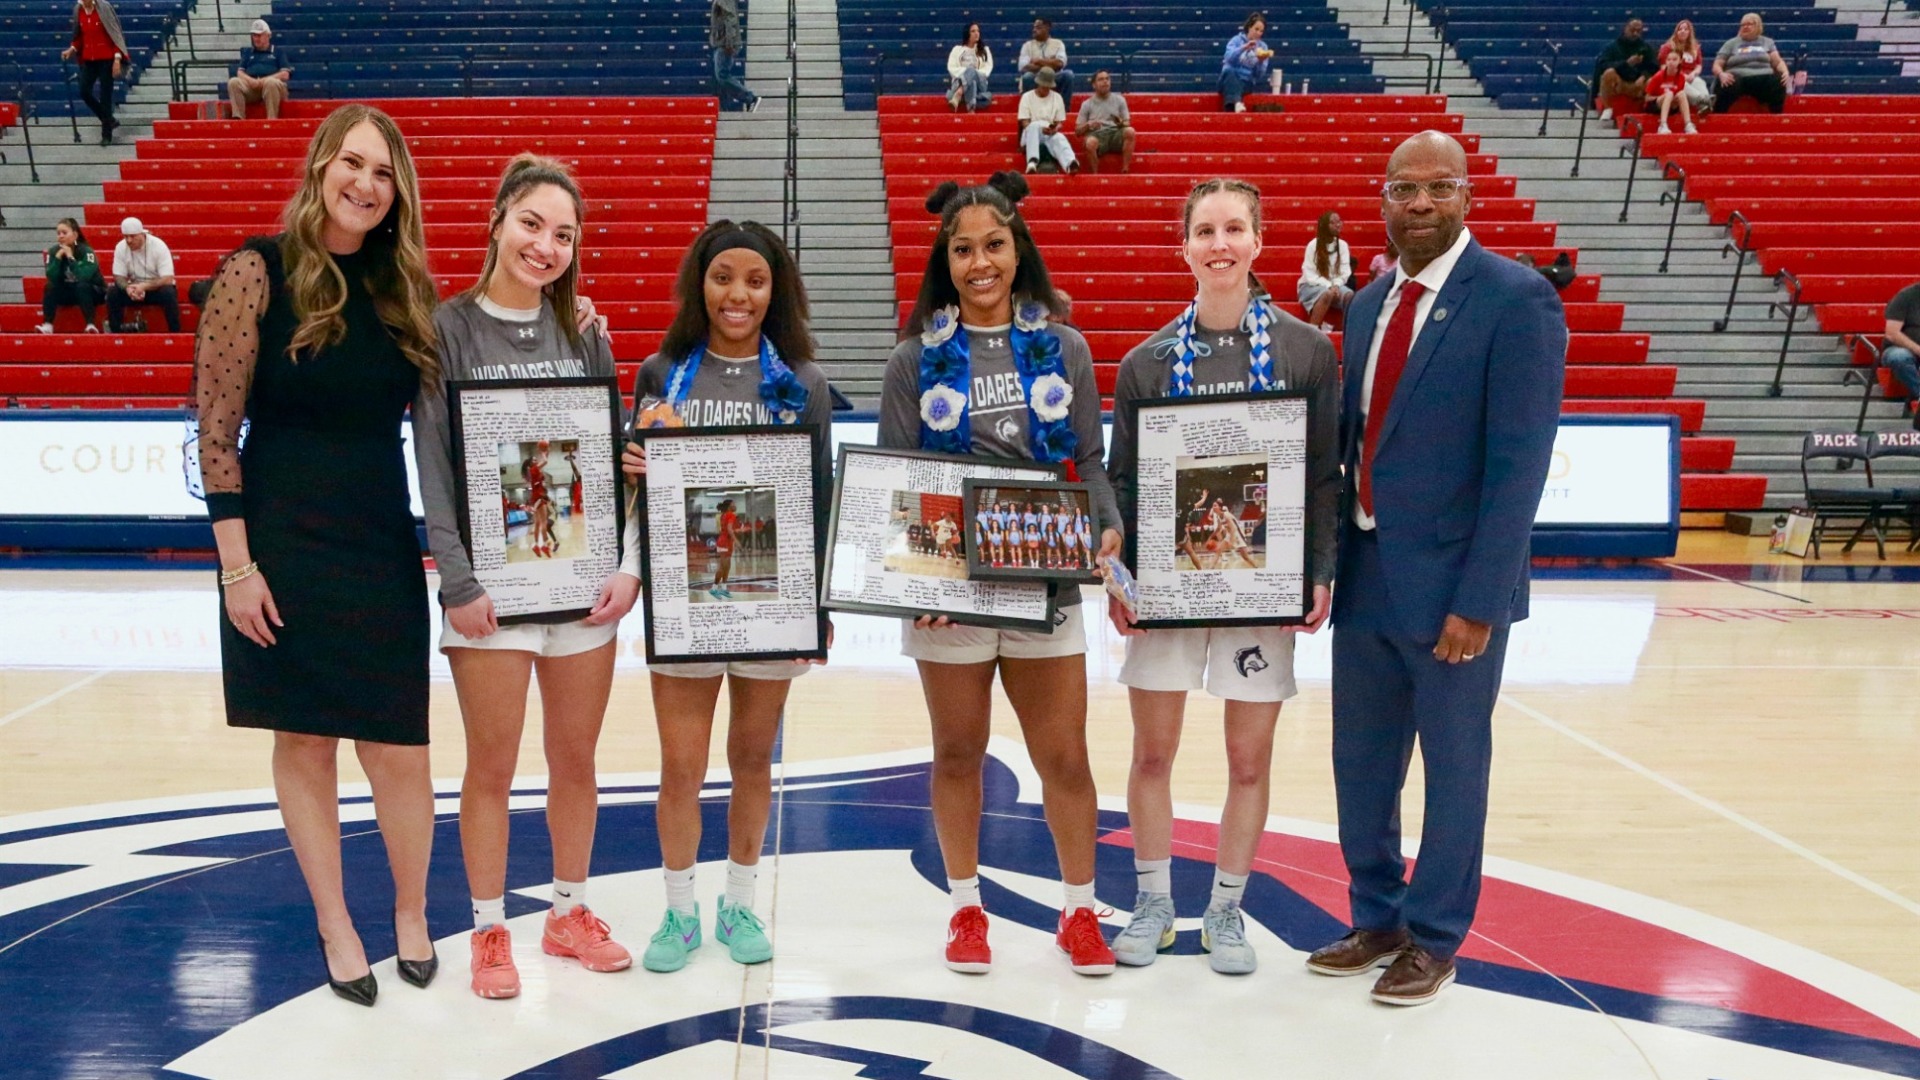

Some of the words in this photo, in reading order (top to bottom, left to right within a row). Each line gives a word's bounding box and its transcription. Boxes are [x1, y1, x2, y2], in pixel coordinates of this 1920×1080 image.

[974, 372, 1025, 407] DARES
[681, 399, 700, 427] HO
[704, 399, 752, 427] DARES
[1813, 434, 1858, 447] PACK
[1877, 433, 1920, 446] PACK
[1655, 607, 1920, 623] ealth
